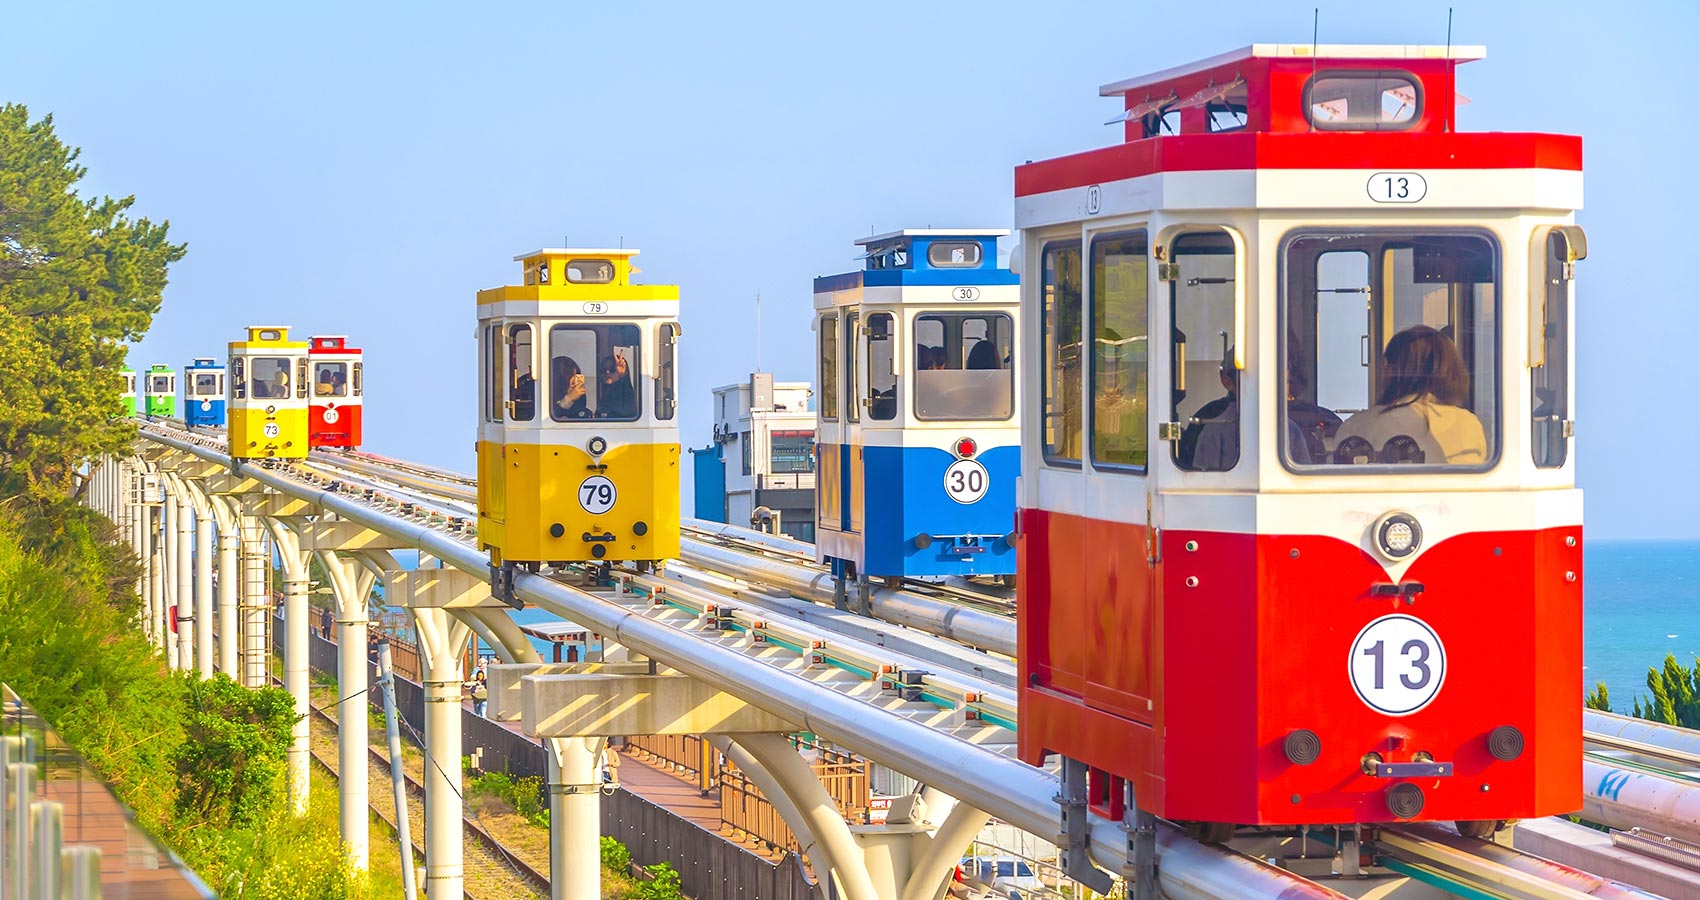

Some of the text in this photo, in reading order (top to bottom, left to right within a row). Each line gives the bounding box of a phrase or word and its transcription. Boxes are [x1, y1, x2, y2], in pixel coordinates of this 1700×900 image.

[1385, 177, 1409, 199] 13
[1091, 189, 1098, 210] 13
[960, 289, 973, 299] 30
[590, 303, 601, 312] 79
[326, 412, 337, 421] 01
[266, 426, 278, 435] 73
[950, 469, 983, 494] 30
[582, 484, 612, 506] 79
[1363, 639, 1432, 691] 13
